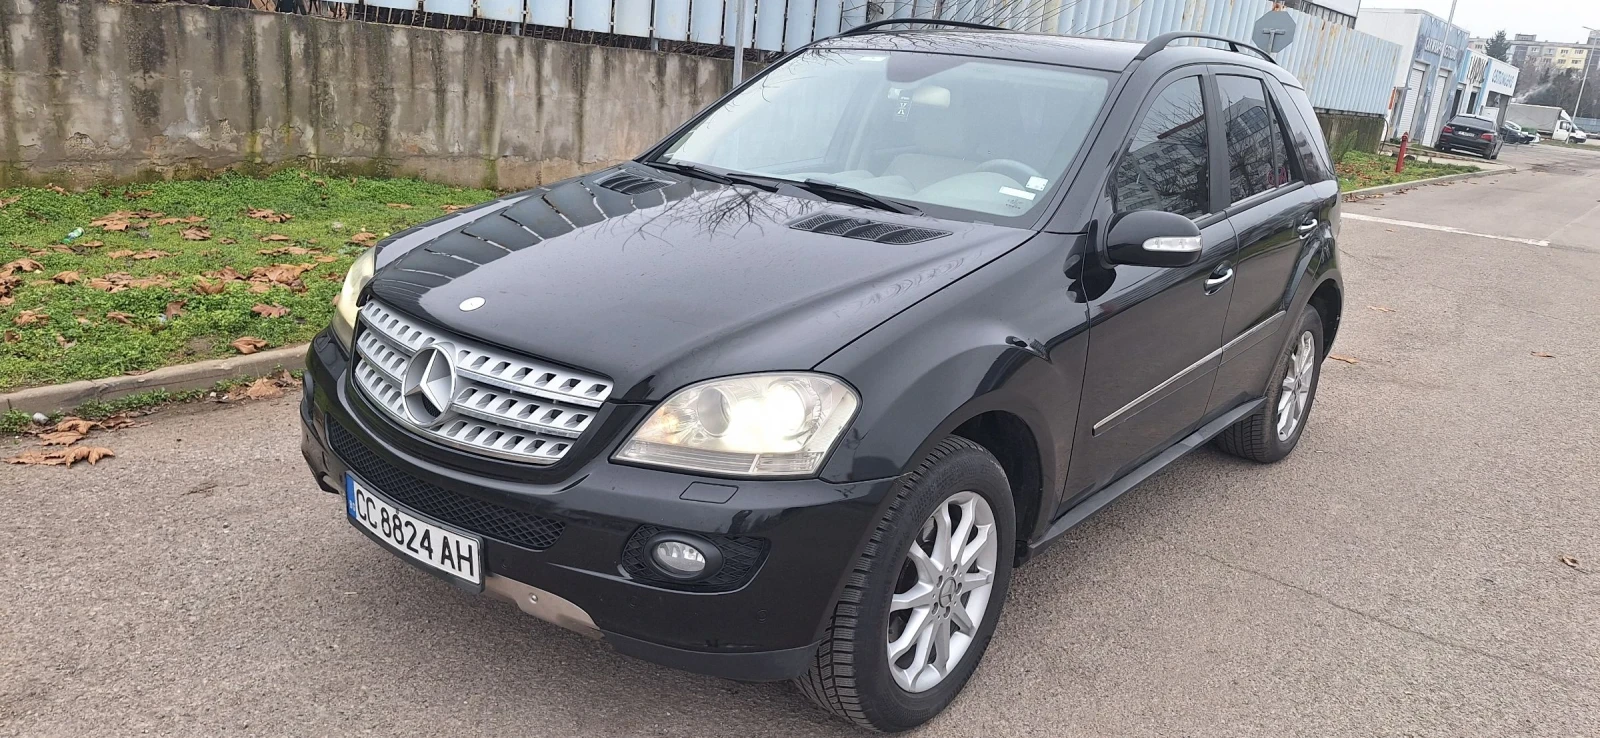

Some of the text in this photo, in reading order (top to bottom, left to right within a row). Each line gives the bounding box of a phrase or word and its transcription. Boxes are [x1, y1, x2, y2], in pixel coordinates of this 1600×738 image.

[356, 489, 474, 577] CC 8824 AH
